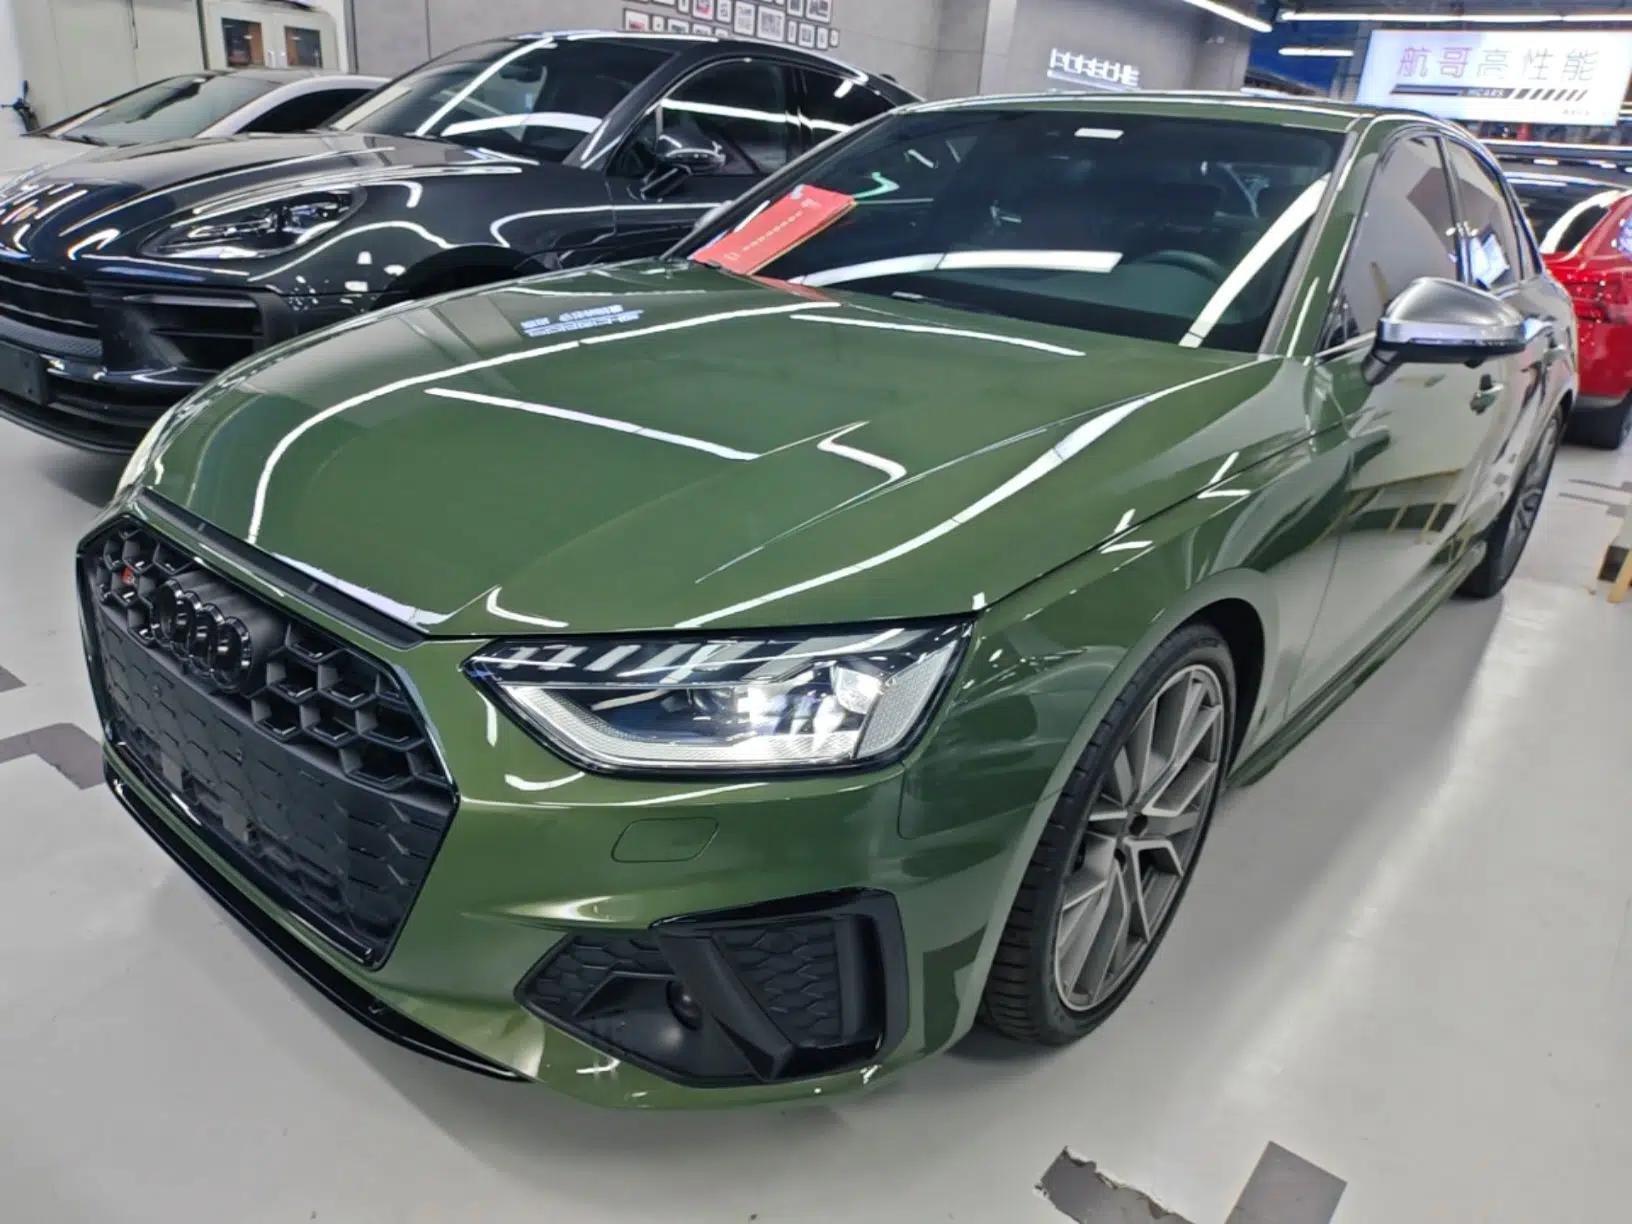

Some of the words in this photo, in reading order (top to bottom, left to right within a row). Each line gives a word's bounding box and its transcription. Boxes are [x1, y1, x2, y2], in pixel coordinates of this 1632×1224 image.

[1398, 47, 1598, 81] 航哥高性能
